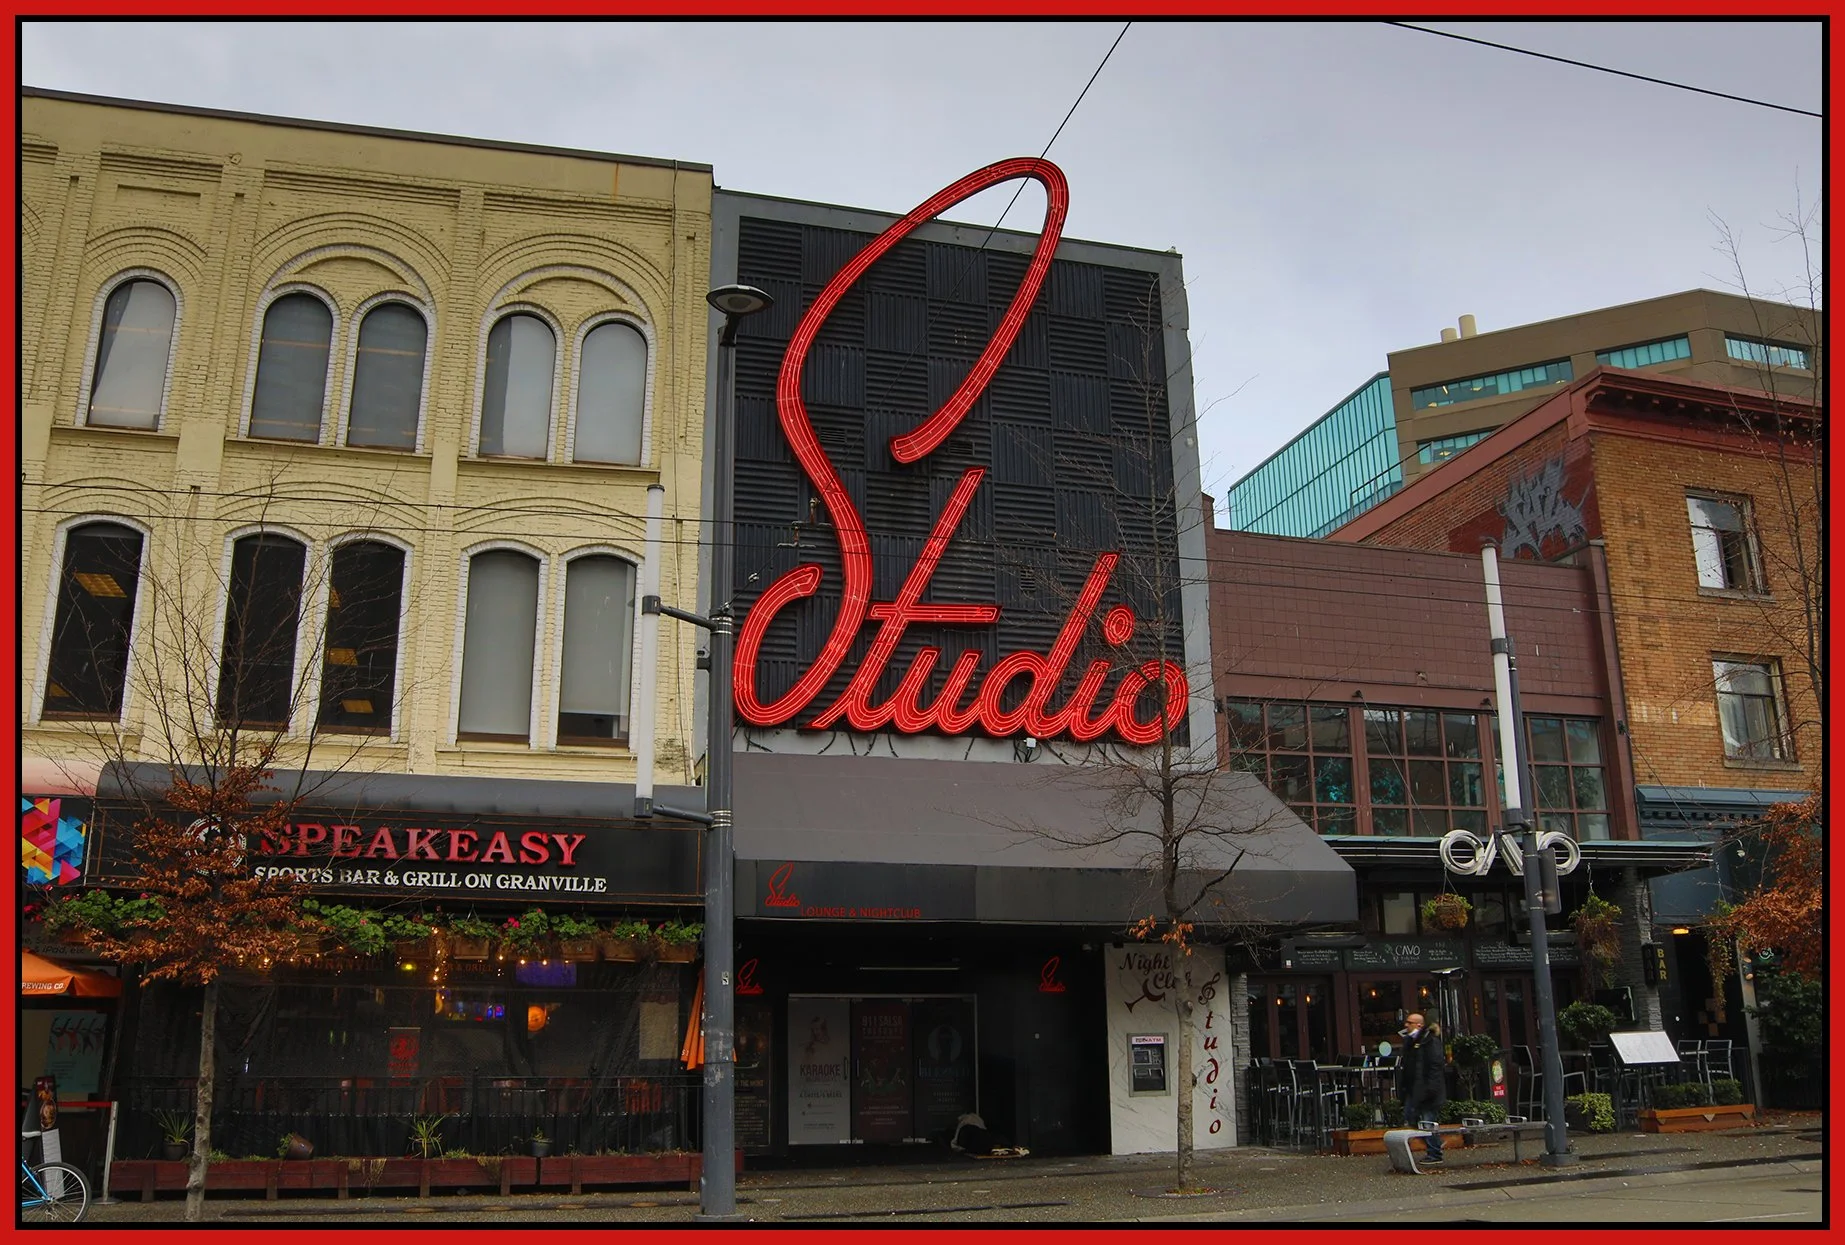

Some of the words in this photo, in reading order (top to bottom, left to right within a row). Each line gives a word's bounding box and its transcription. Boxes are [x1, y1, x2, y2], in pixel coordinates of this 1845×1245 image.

[733, 156, 1189, 745] Studio
[260, 821, 587, 867] SPEAKEASY
[254, 866, 333, 884] SPORTS
[339, 868, 381, 885] BAR
[384, 870, 399, 886] &
[402, 870, 462, 888] GRILL
[464, 872, 493, 889] ON
[495, 873, 608, 893] GRANVILLE
[800, 906, 845, 917] LOUNGE
[848, 907, 857, 917] &
[860, 907, 921, 919] NIGHTCLUB
[1119, 952, 1171, 976] Night
[1656, 948, 1668, 980] BAR
[799, 1063, 841, 1077] KARAOKE
